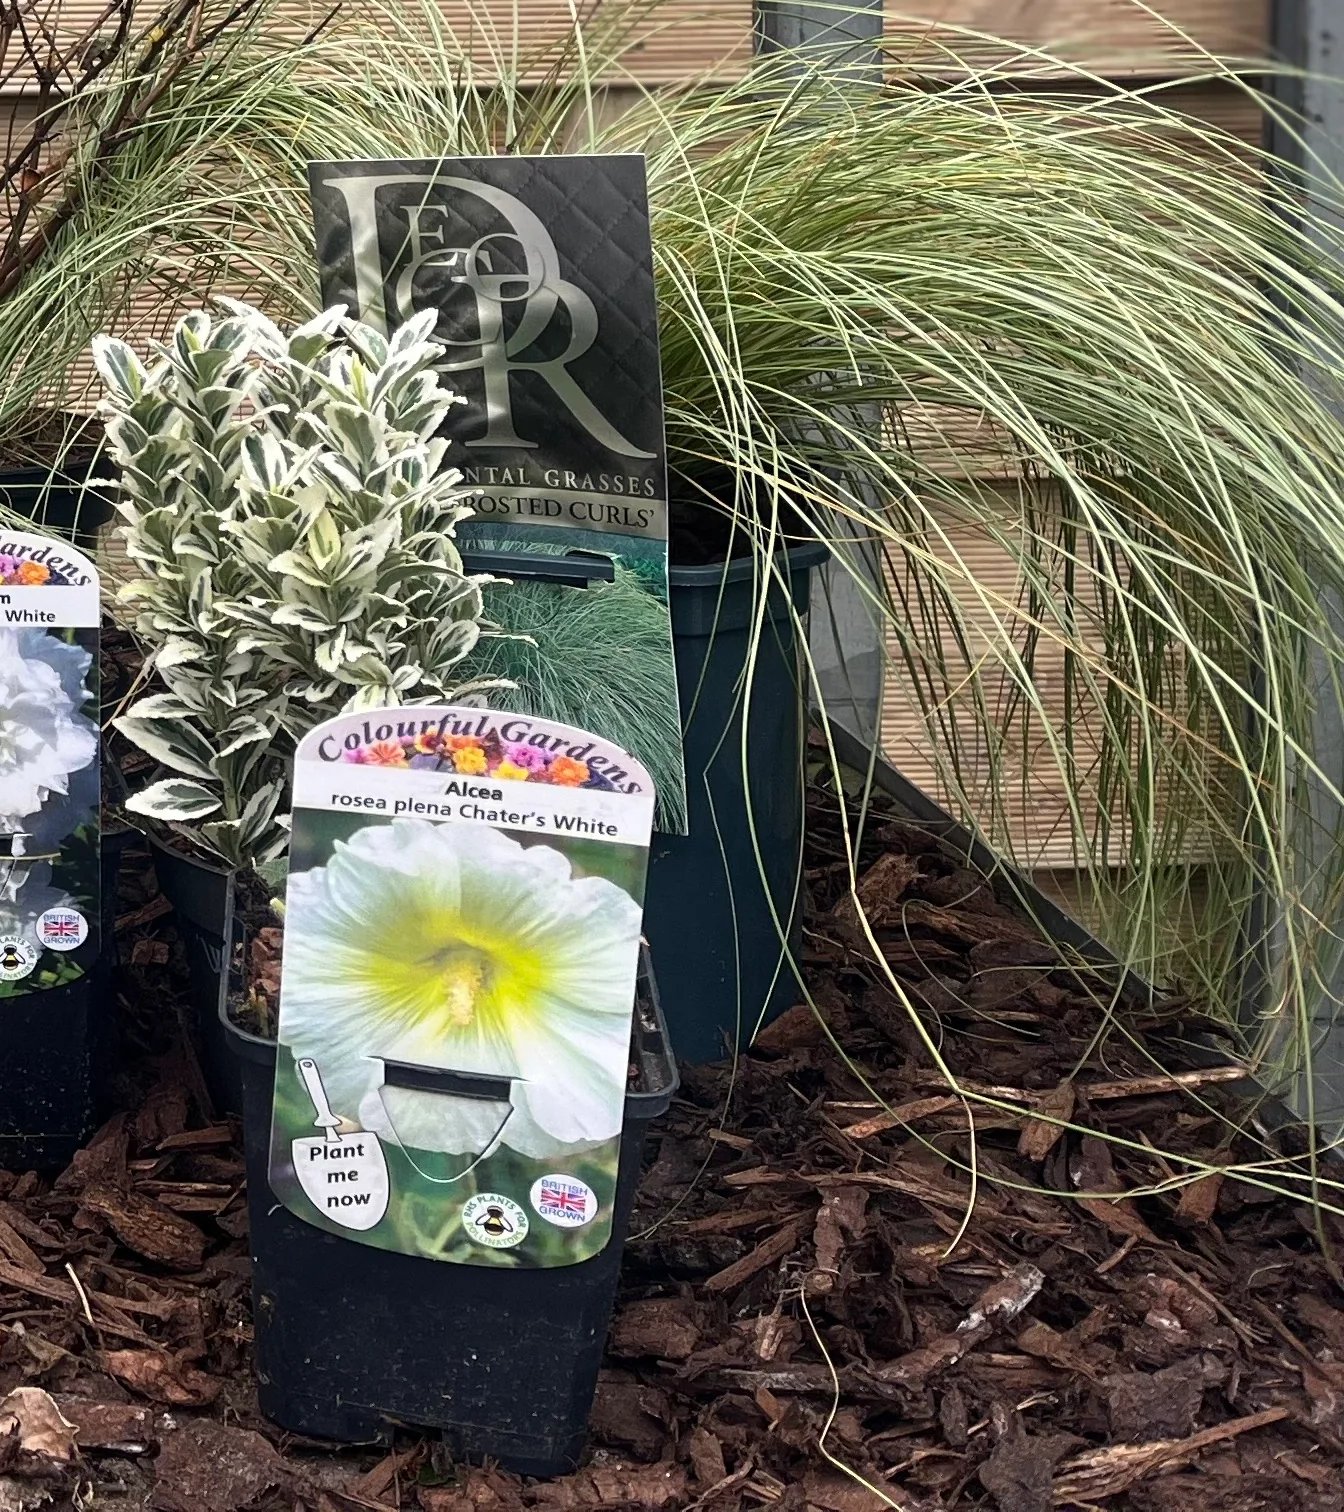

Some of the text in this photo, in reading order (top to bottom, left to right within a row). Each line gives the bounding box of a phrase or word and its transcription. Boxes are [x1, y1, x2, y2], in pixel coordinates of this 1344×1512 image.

[544, 469, 655, 497] GRASSES
[463, 495, 655, 528] ROSTED CURLS'
[4, 609, 56, 623] White
[318, 713, 643, 797] Colourful Gardens
[444, 780, 503, 802] Alcea
[331, 793, 618, 838] rosea plena Chater's White
[309, 1142, 365, 1161] Plant
[327, 1170, 359, 1184] me
[541, 1178, 588, 1196] BRITISH
[327, 1192, 371, 1208] now
[464, 1194, 527, 1228] RHS PLANTS FOR
[539, 1205, 586, 1222] GROWN
[465, 1221, 525, 1247] POLLINATORS
